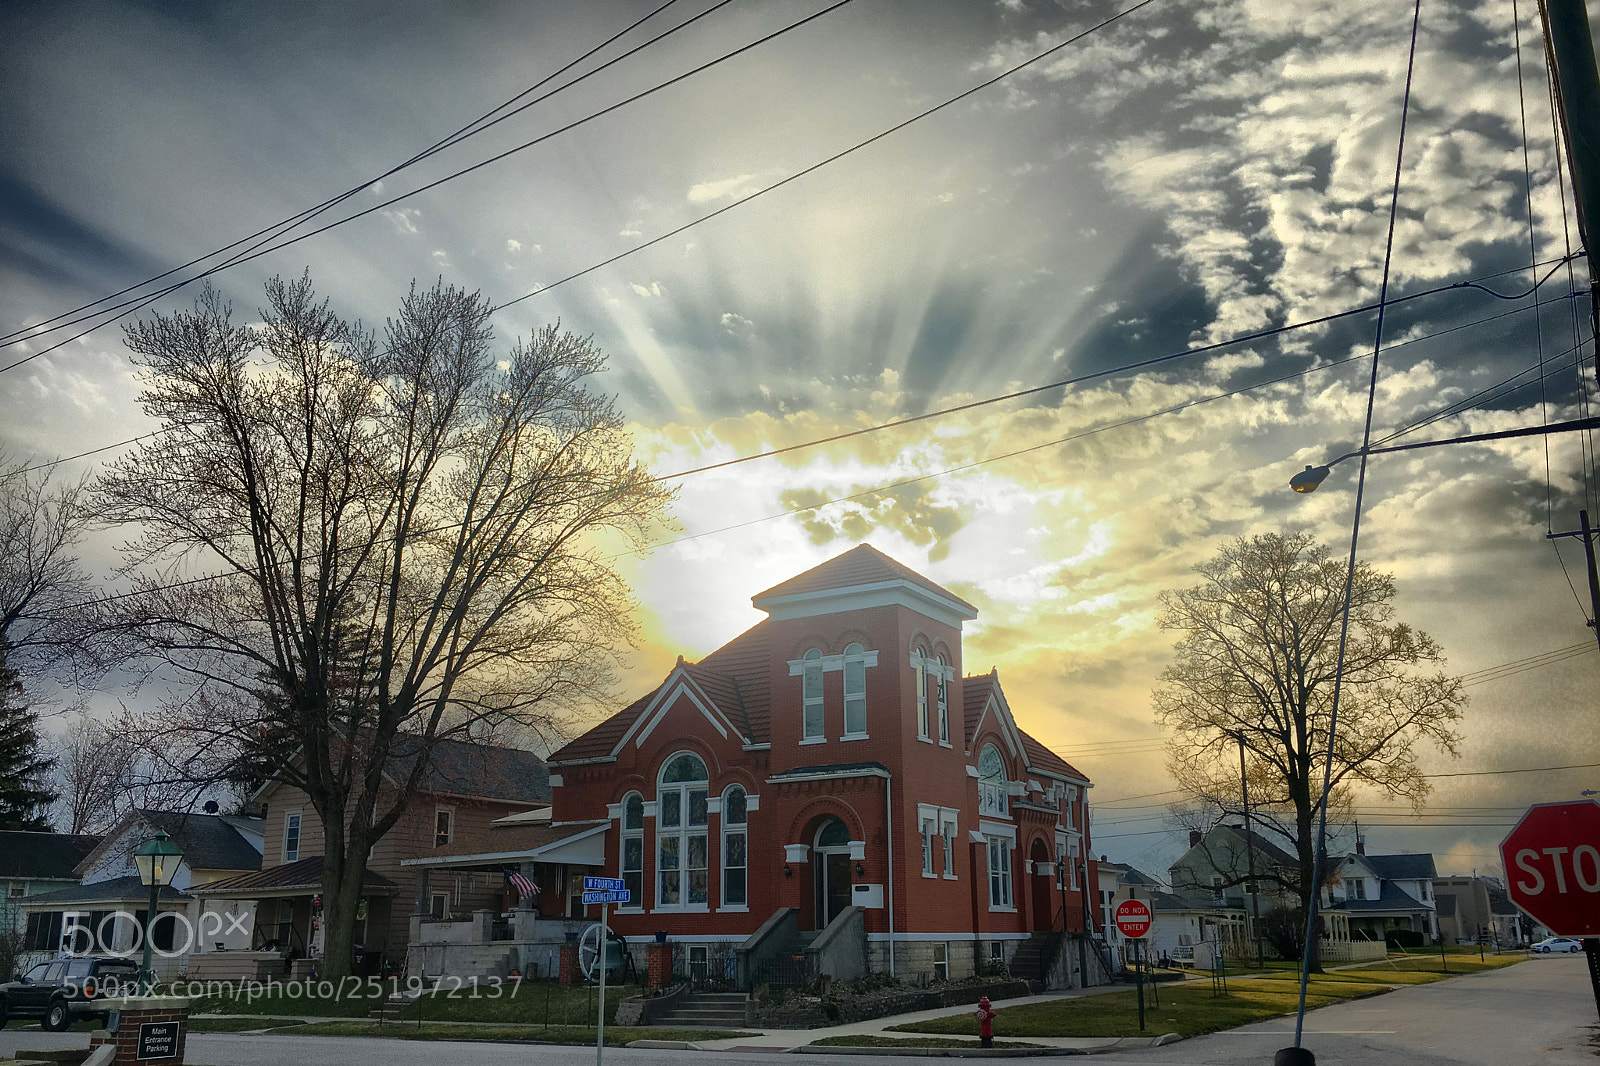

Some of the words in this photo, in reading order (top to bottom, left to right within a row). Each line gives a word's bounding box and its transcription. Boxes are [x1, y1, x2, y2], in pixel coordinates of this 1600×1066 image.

[1515, 844, 1600, 896] STO
[588, 879, 593, 888] W
[594, 879, 614, 889] FOURTH
[615, 880, 622, 890] ST
[584, 891, 617, 902] WASHINGTON
[618, 891, 628, 901] AVE
[1123, 923, 1144, 931] ENTER
[151, 1027, 167, 1035] Main
[144, 1036, 172, 1044] Entrance
[146, 1045, 169, 1053] Parking
